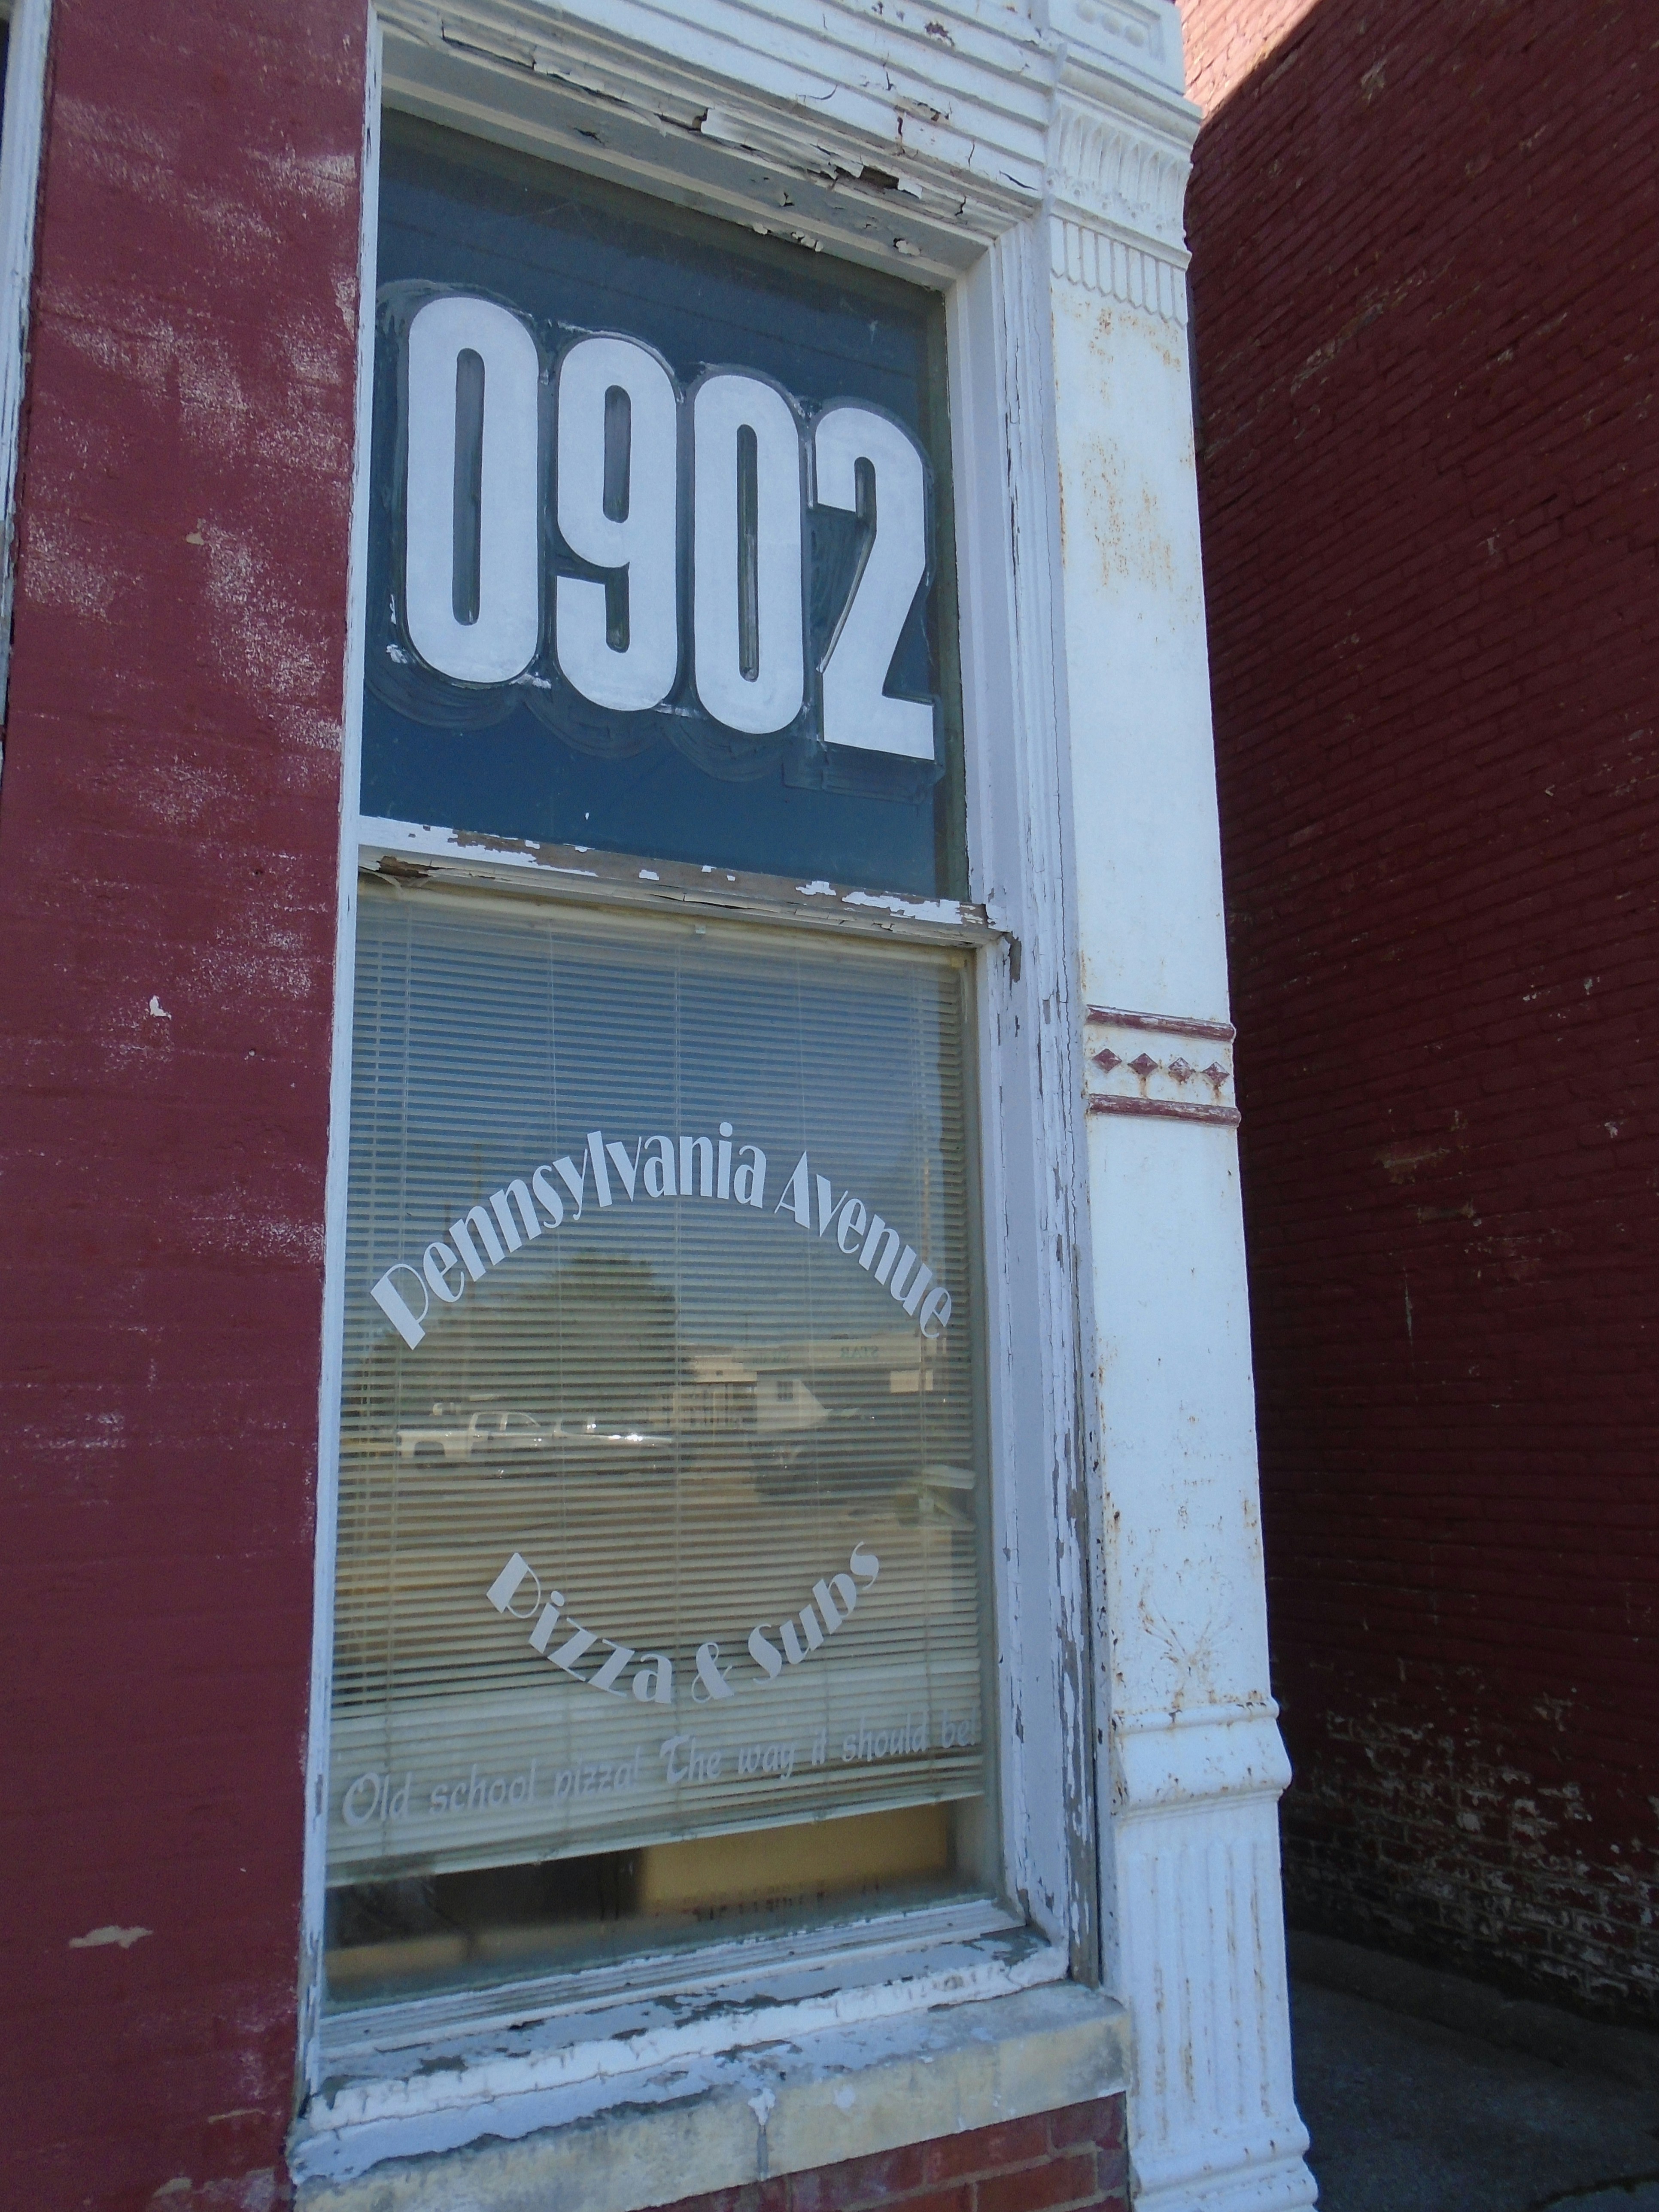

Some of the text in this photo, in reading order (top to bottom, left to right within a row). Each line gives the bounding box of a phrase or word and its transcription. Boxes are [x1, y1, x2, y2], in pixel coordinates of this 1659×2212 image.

[406, 297, 934, 760] 0902
[370, 1122, 952, 1350] Pennsylvania Avenue
[486, 1541, 879, 1704] Pizza & Subs
[342, 1771, 413, 1827] Old
[429, 1759, 538, 1813] school
[659, 1734, 721, 1784] The
[738, 1742, 796, 1780] way
[811, 1725, 827, 1765] it
[842, 1710, 929, 1762] should
